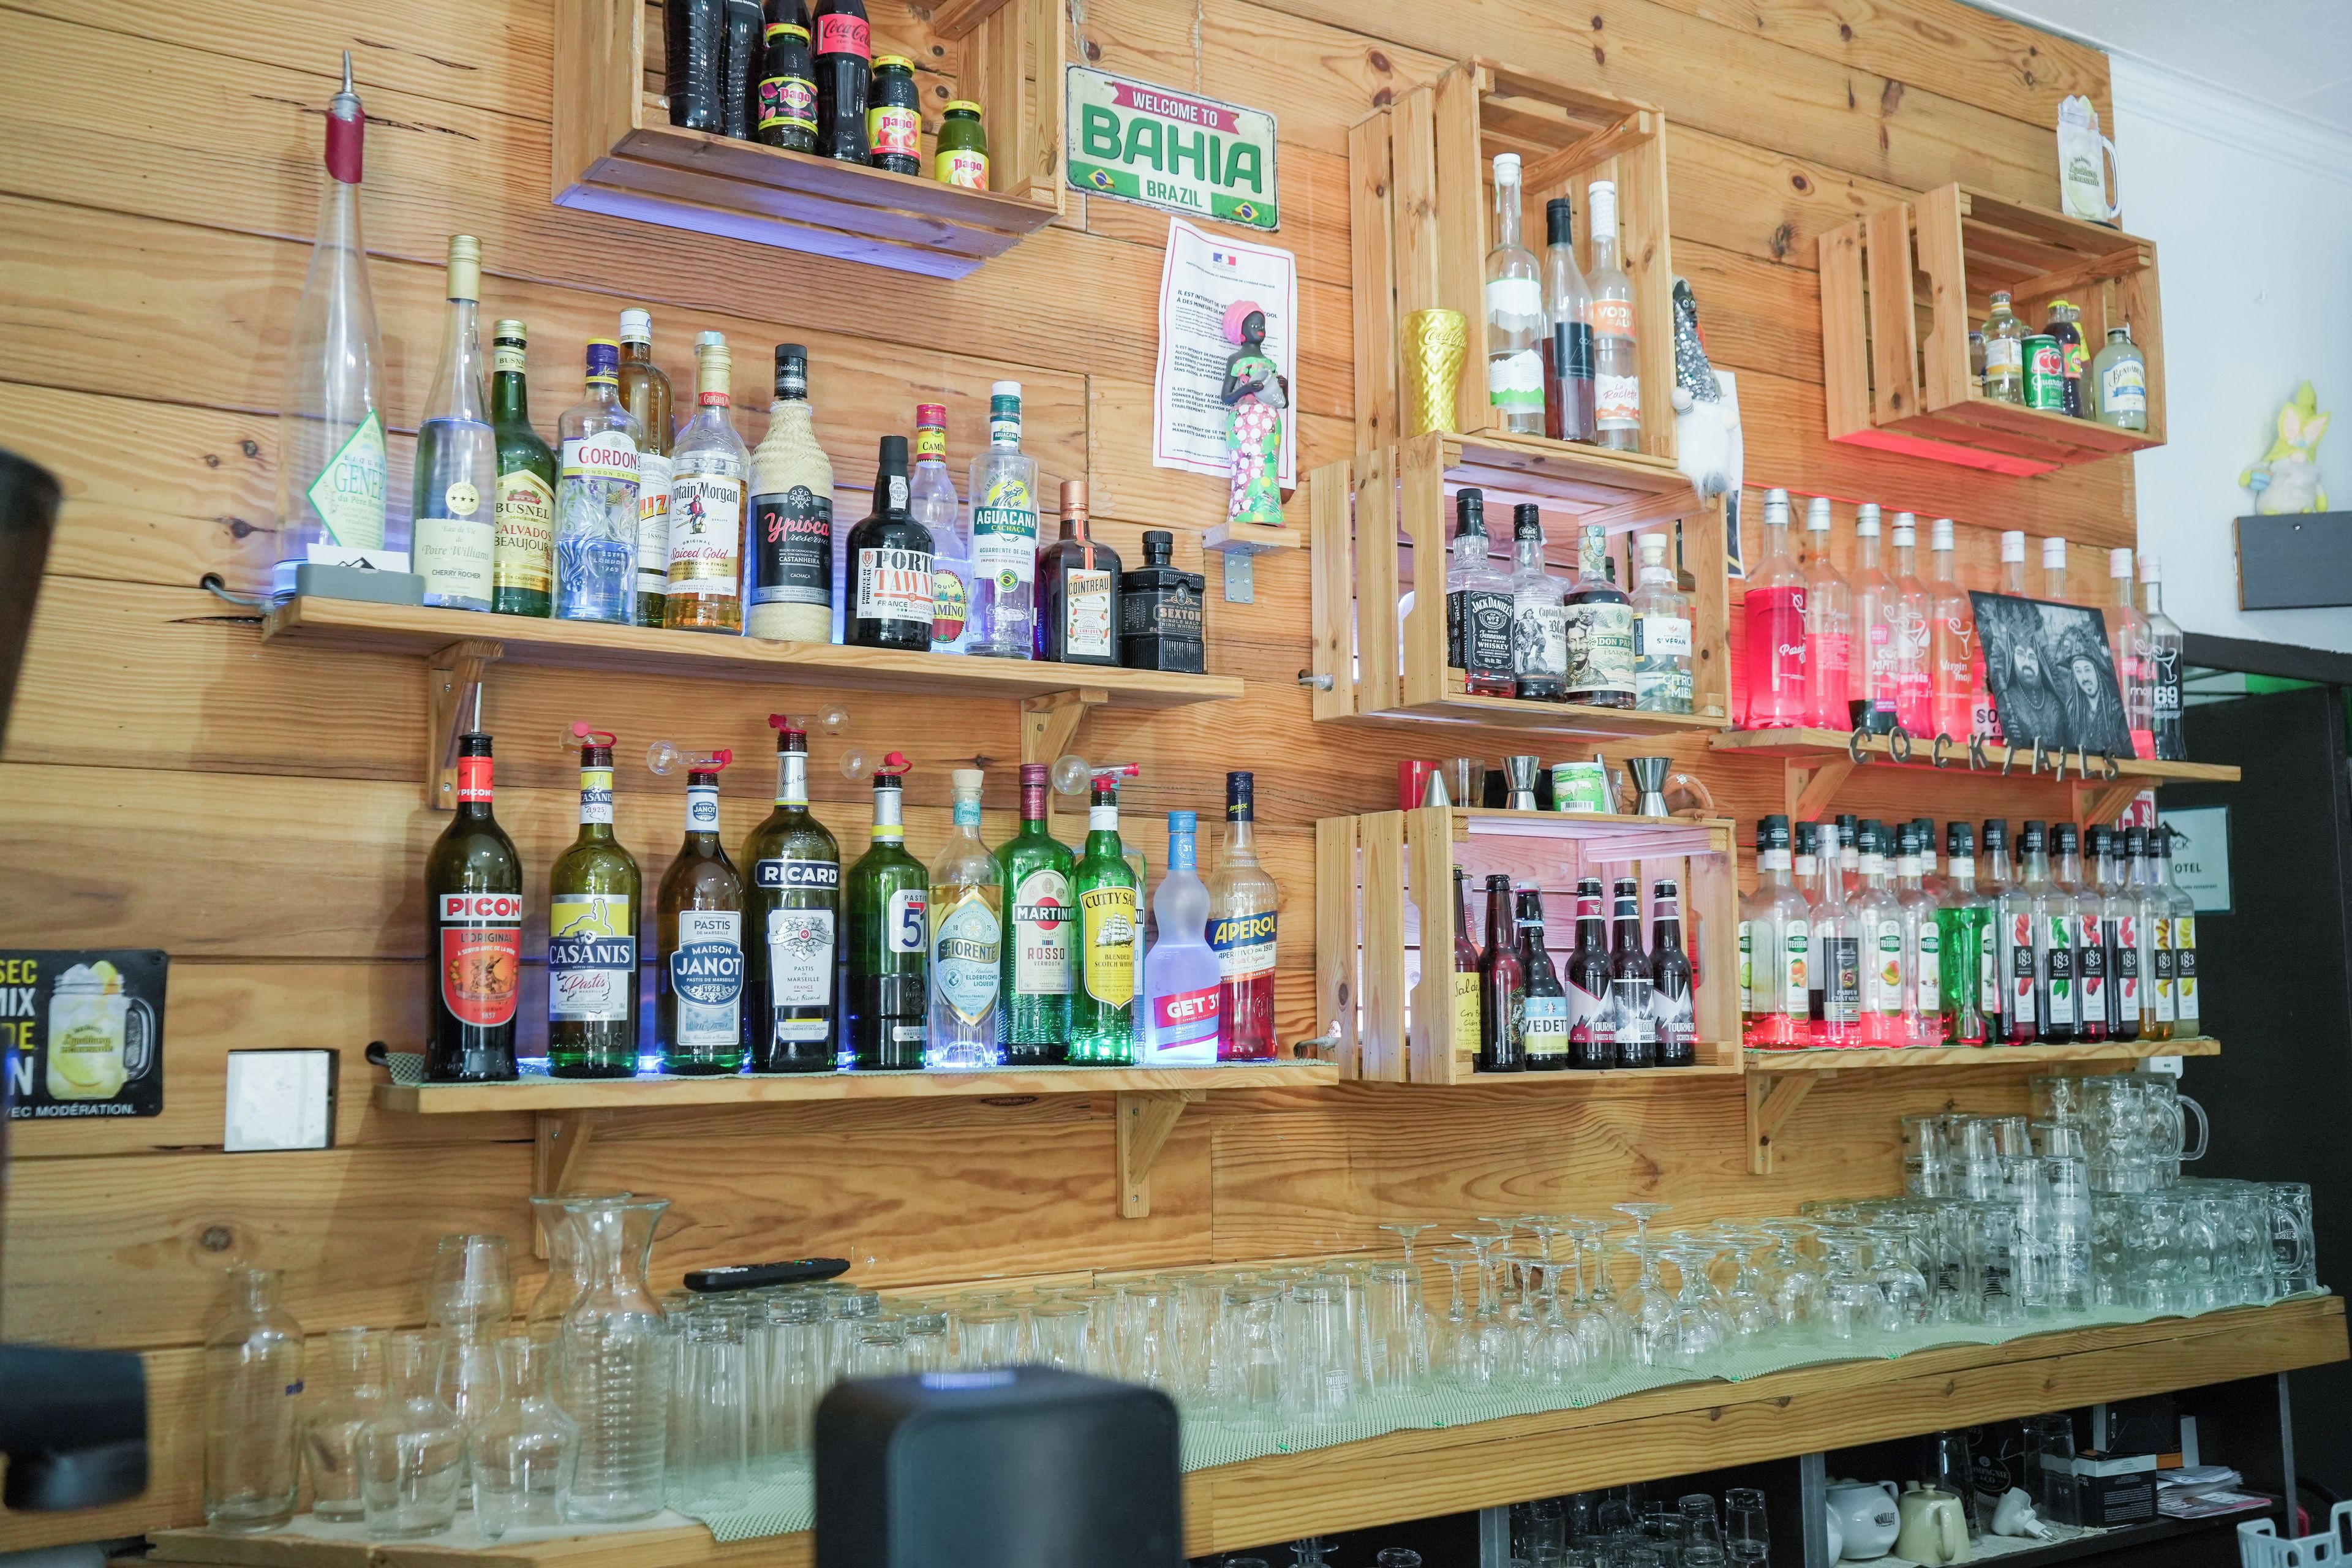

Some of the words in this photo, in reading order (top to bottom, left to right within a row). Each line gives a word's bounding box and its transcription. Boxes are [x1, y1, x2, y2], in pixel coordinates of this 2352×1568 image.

[778, 87, 811, 104] pago
[1133, 91, 1198, 123] WELCOME
[1202, 108, 1218, 127] TO
[881, 116, 913, 130] pago
[1082, 103, 1262, 194] BAHIA
[953, 158, 982, 171] pago
[1147, 179, 1203, 208] BRAZIL
[1194, 301, 1213, 312] MINEURS
[1195, 293, 1214, 306] INTERDIT
[2031, 374, 2064, 387] Guaran
[704, 393, 725, 405] Captain
[1603, 388, 1637, 400] Raclette
[578, 446, 641, 471] GORDON'S
[697, 481, 738, 505] Morgan
[496, 503, 549, 520] BUSNEL
[639, 494, 670, 521] UZ
[764, 511, 830, 543] Ypióca
[976, 510, 1036, 530] AGUACANA
[495, 522, 552, 542] CALVADOS
[991, 524, 1025, 533] CACHAÇA
[494, 536, 548, 552] BEAUJOUR
[788, 533, 830, 546] reserva
[421, 545, 447, 556] Poire
[450, 546, 490, 560] Williams
[671, 547, 701, 560] Spiced
[703, 547, 728, 560] Gold
[778, 556, 820, 565] CASTANHEIRA
[458, 570, 481, 579] ROCHER
[1069, 577, 1109, 595] COINTREAU
[877, 600, 908, 608] FRANCE
[1471, 600, 1488, 613] JACK
[1488, 597, 1513, 619] DANIEL'S
[1159, 608, 1201, 622] SEXTON
[1539, 607, 1559, 619] Captain
[1479, 630, 1507, 641] Tennessee
[1598, 637, 1617, 646] DON
[1619, 638, 1632, 648] PAP
[1665, 637, 1686, 646] VÉRAN
[1477, 641, 1509, 650] WHISKEY
[1940, 660, 1967, 674] Virgin
[1662, 673, 1692, 687] CITRO
[1671, 687, 1692, 698] MIEL
[2154, 686, 2179, 704] 69
[1849, 726, 2119, 782] COCKTAILS
[461, 788, 491, 797] PICON
[581, 792, 612, 804] CASANIS
[1229, 803, 1248, 813] APEROL
[764, 866, 838, 883] RICARD
[2174, 864, 2202, 873] OTEL
[447, 898, 520, 916] PICON
[1085, 892, 1121, 910] CUTTY
[1017, 907, 1071, 921] MARTINI
[694, 921, 731, 930] PASTIS
[901, 908, 927, 948] 51
[1213, 914, 1276, 945] APEROL
[461, 933, 513, 943] L'ORIGINAL
[549, 944, 630, 964] CASANIS
[692, 945, 732, 956] MAISON
[944, 942, 996, 960] FIORENTE
[1027, 947, 1065, 960] ROSSO
[1218, 948, 1254, 960] APERITIVO
[1263, 943, 1273, 952] 1919
[0, 959, 38, 985] SEC
[676, 957, 741, 977] JANOT
[565, 973, 605, 995] Pastis
[1166, 996, 1206, 1019] GET
[1209, 992, 1219, 1010] 31
[1526, 1019, 1567, 1033] VEDETT
[1593, 1022, 1616, 1032] TOURMEN
[35, 1102, 137, 1118] MODÉRATION.
